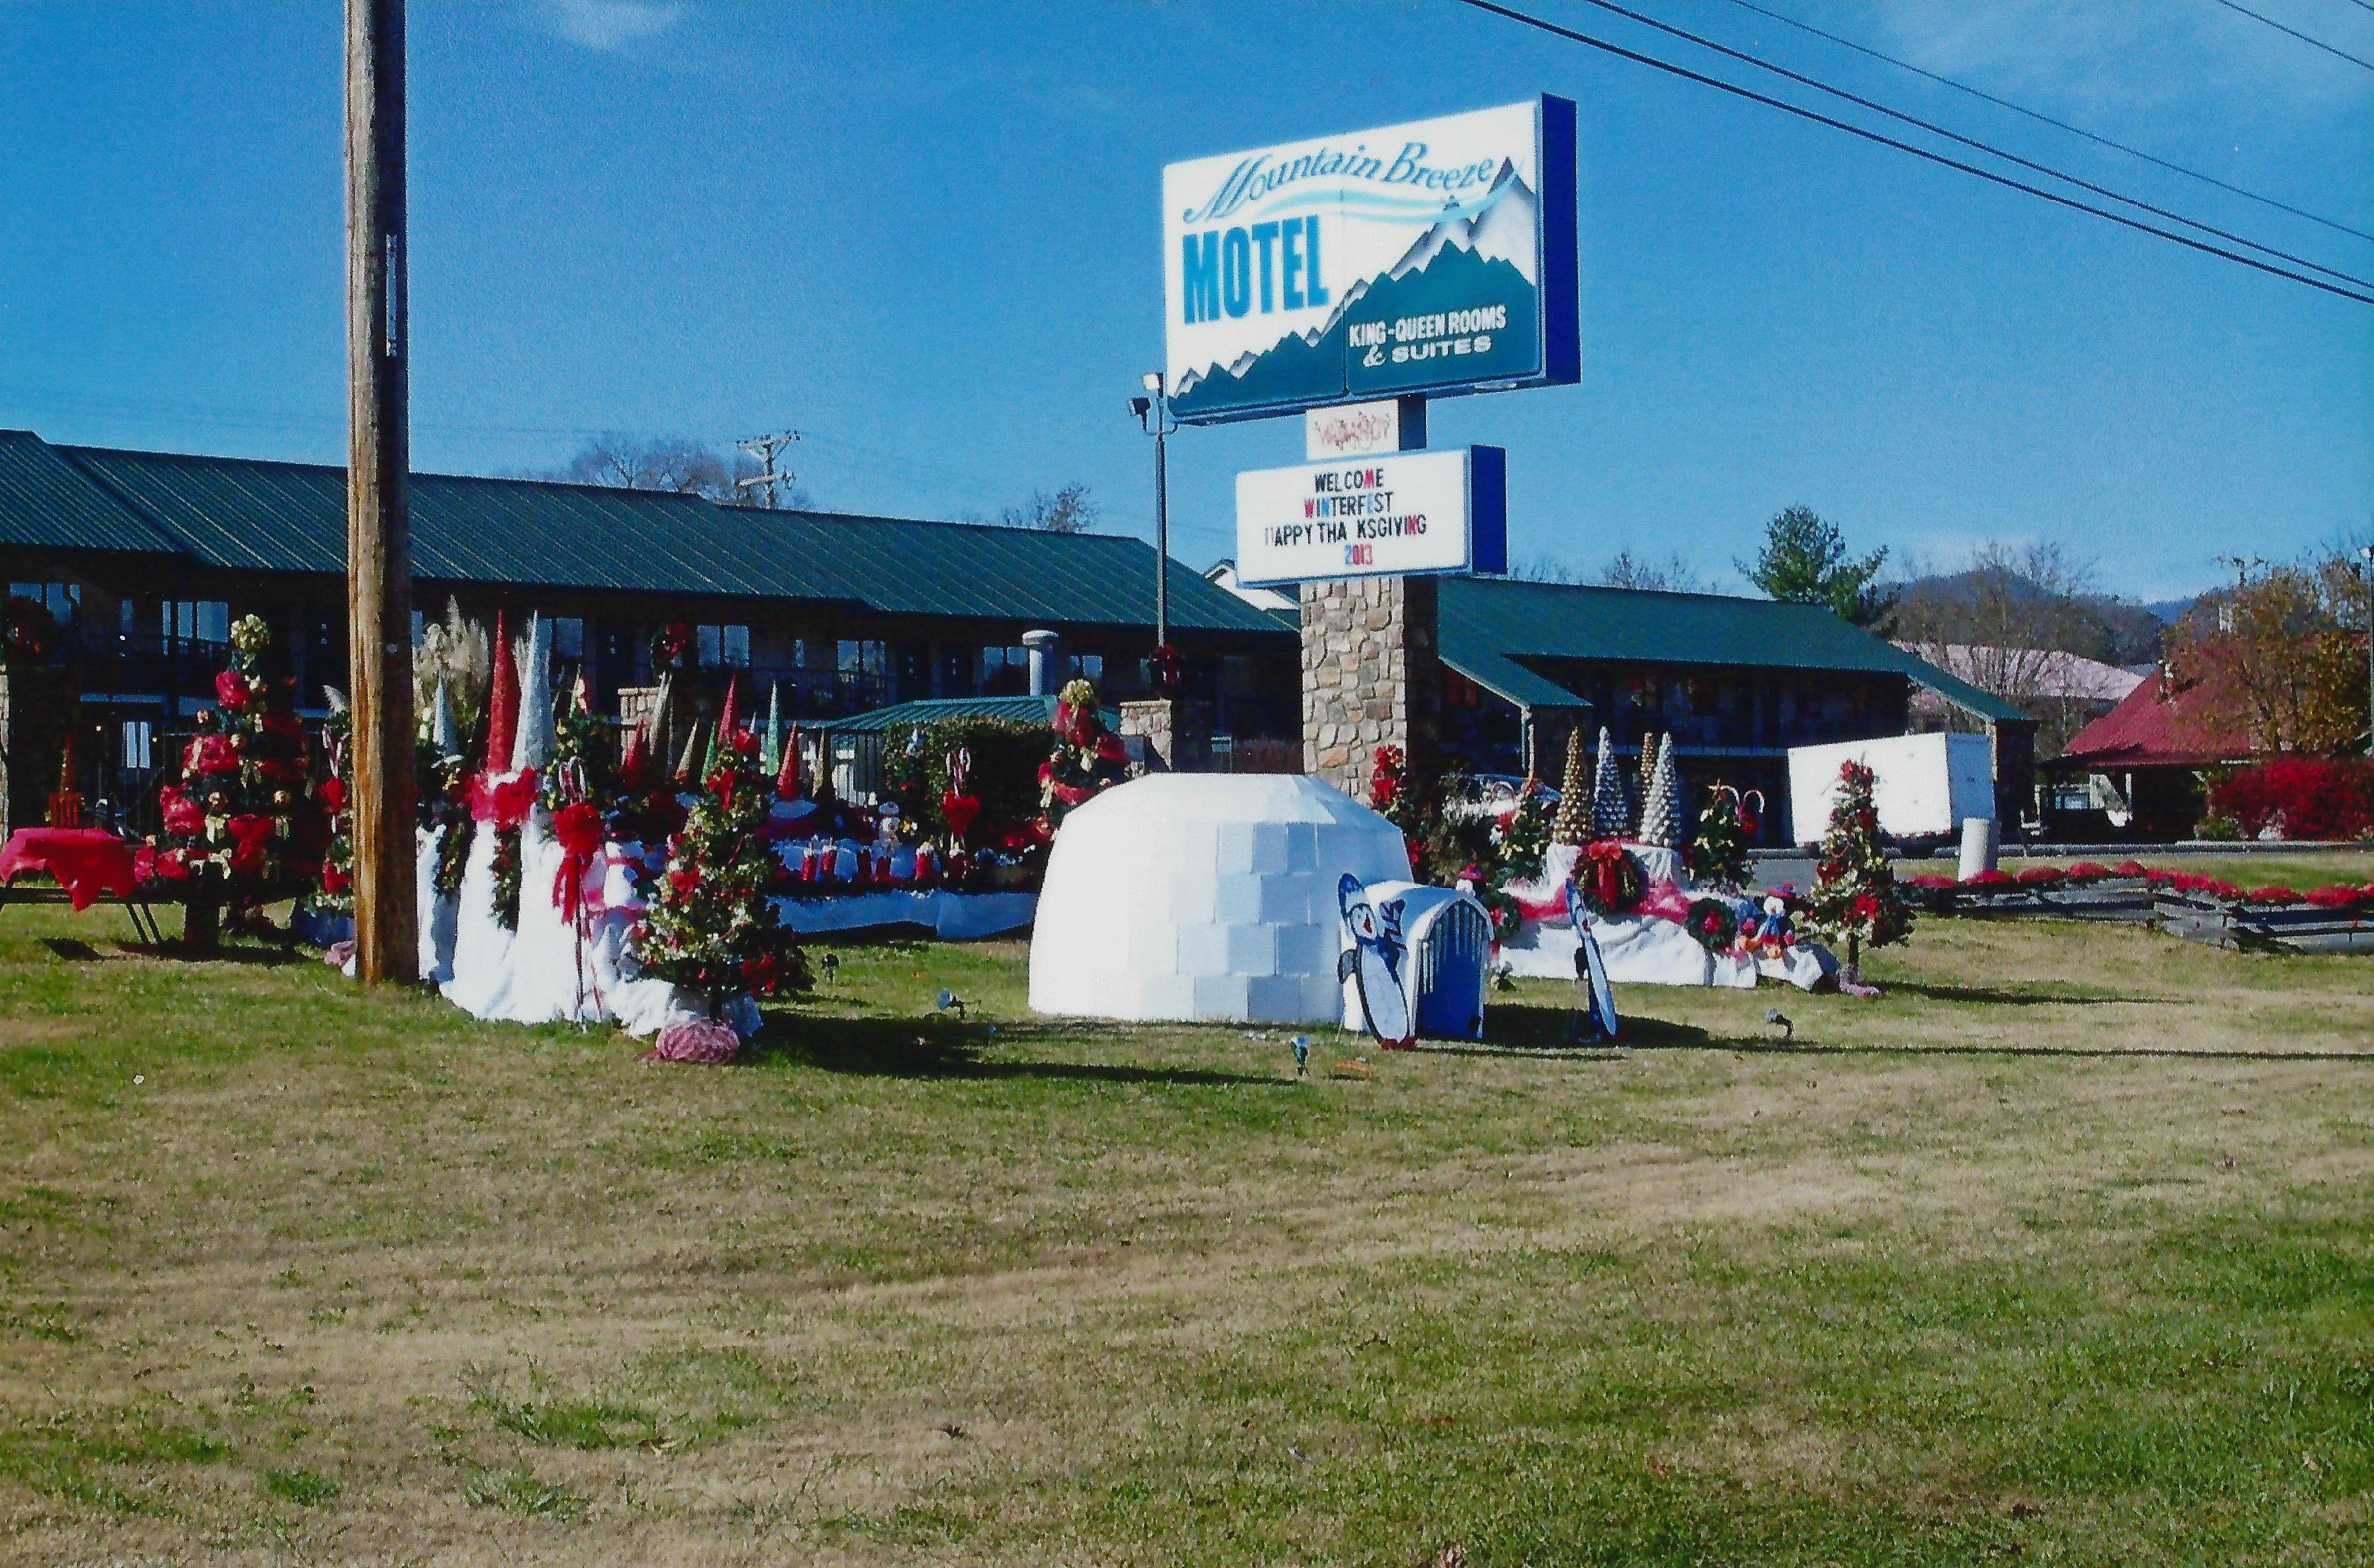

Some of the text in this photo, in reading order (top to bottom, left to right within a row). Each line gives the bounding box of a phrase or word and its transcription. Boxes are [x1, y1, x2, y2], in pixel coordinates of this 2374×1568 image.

[1183, 141, 1494, 222] Mountain Breeze
[1183, 215, 1329, 324] MOTEL
[1349, 304, 1507, 348] KING-QUEEN ROOMS
[1363, 336, 1491, 367] & SUITES
[1315, 467, 1384, 492] WELCOME
[1304, 491, 1394, 518] WINTERFEST
